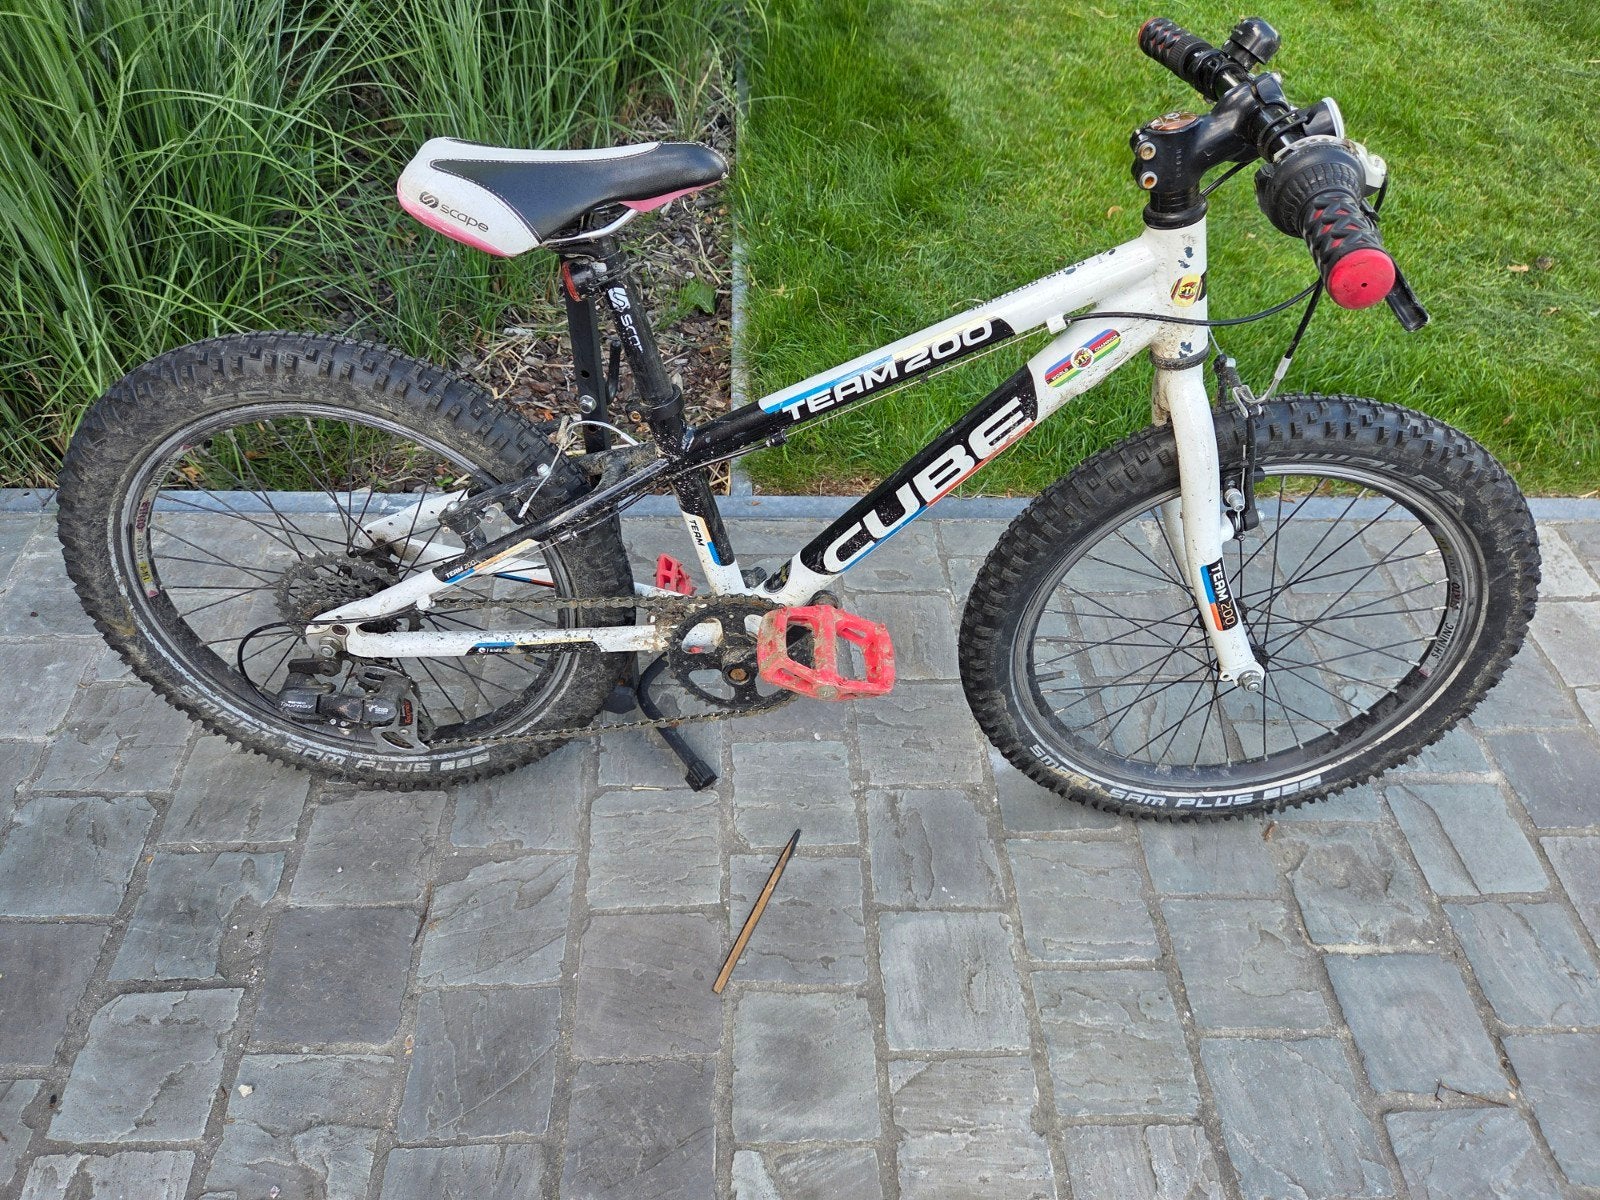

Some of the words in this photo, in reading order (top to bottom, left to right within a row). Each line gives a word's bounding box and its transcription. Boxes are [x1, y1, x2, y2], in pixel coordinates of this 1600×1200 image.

[440, 204, 489, 233] scape
[782, 359, 899, 420] TEAM
[904, 320, 993, 373] 200
[822, 395, 1035, 574] CUBE
[689, 520, 706, 547] TEAM
[445, 565, 464, 579] TEAM
[1211, 562, 1230, 602] TEAM
[1220, 599, 1236, 625] 200
[285, 741, 348, 766] SAM
[356, 759, 432, 773] PLUS
[1109, 787, 1168, 807] SAM
[1175, 793, 1255, 808] PLUS
